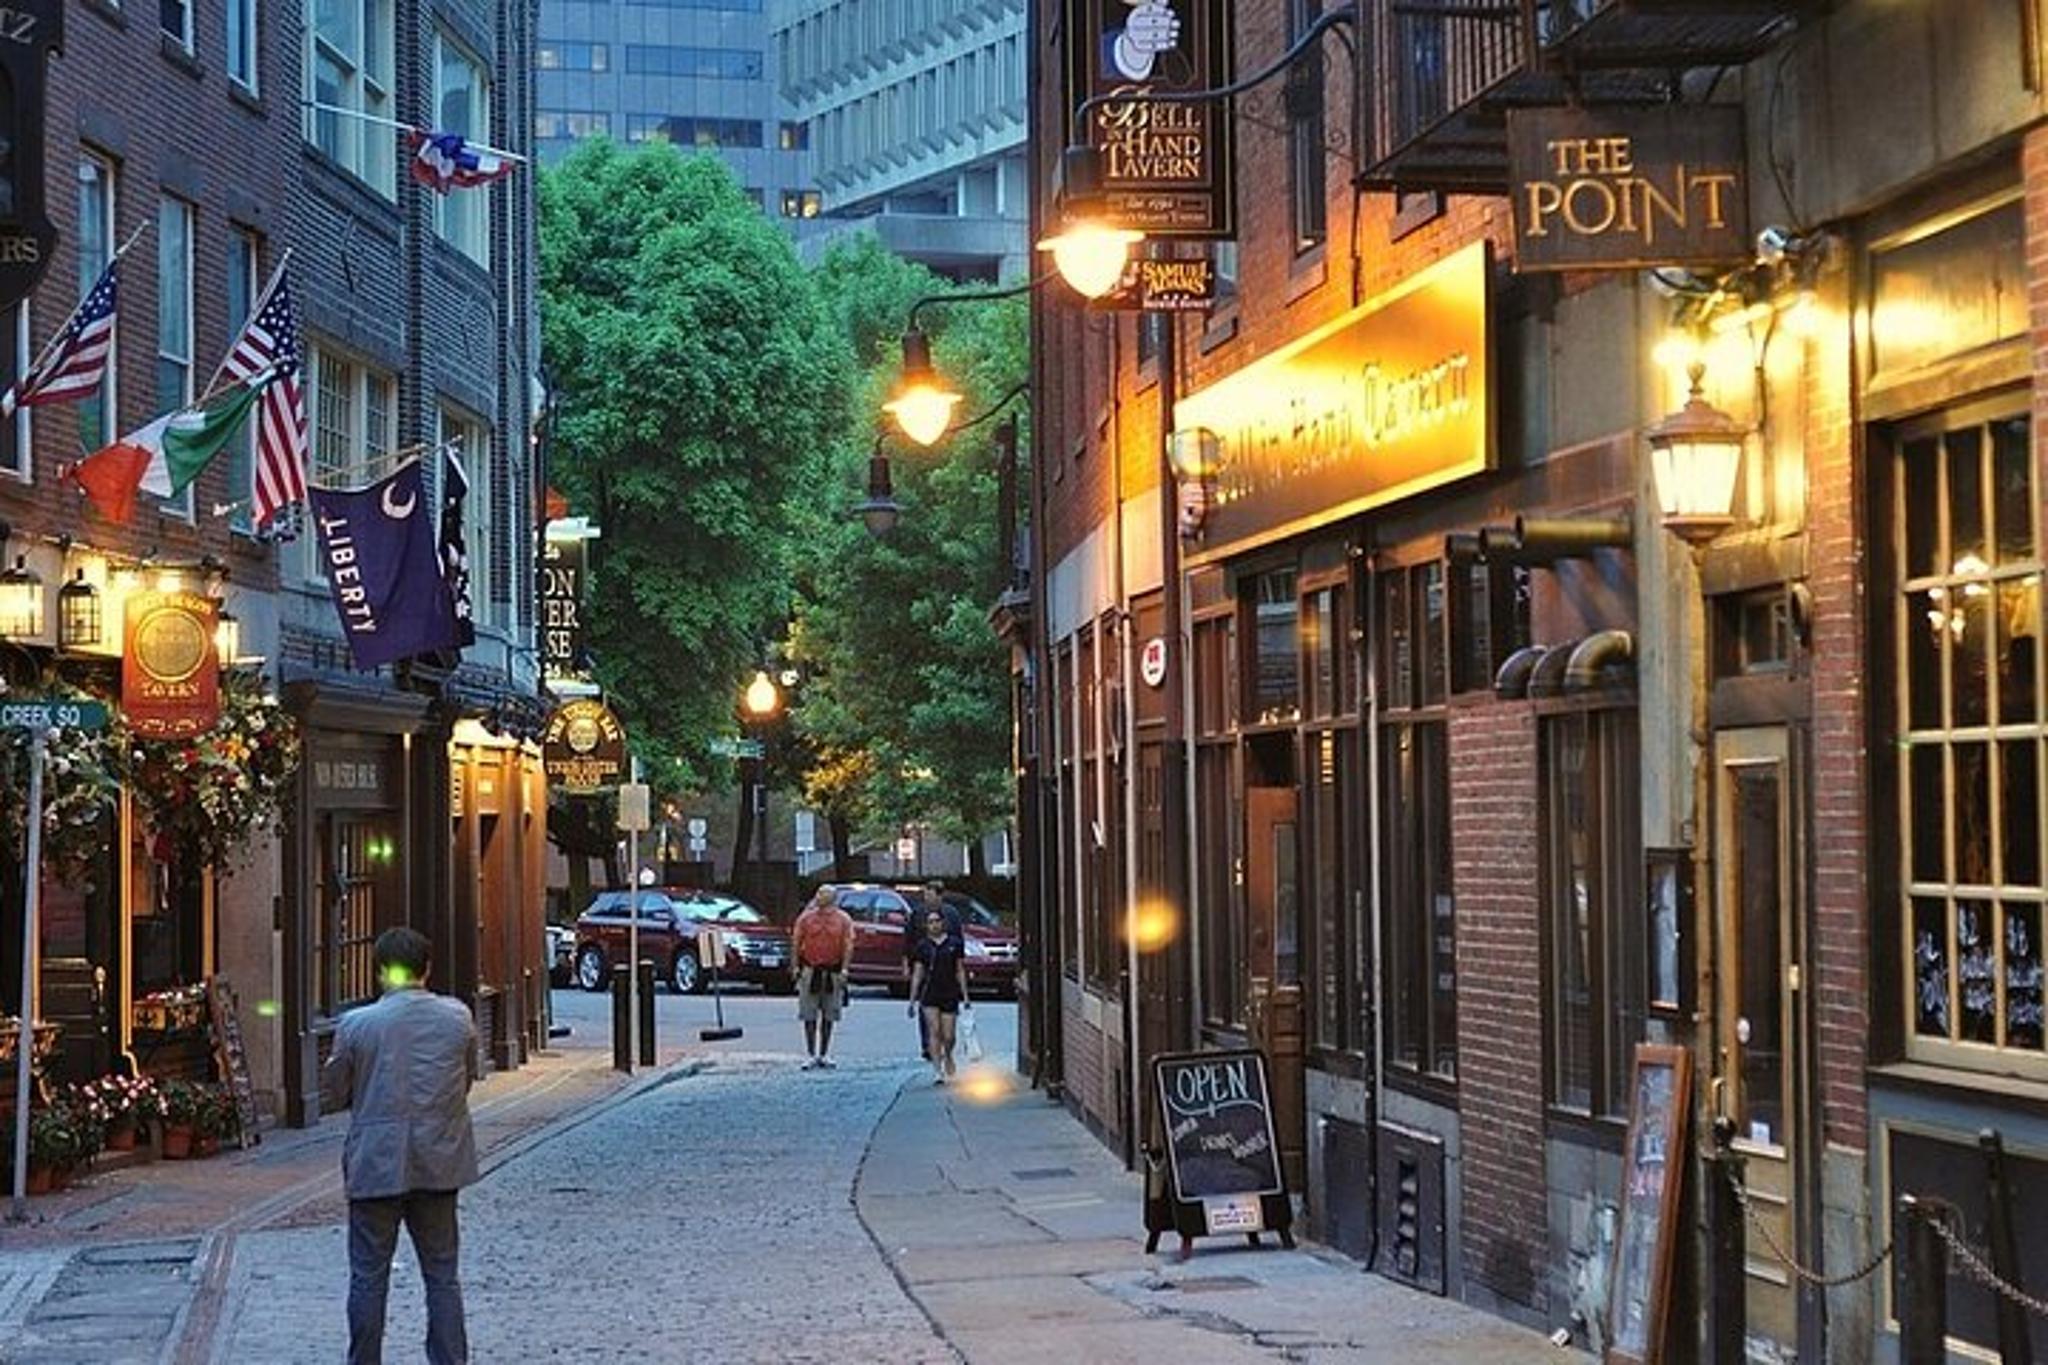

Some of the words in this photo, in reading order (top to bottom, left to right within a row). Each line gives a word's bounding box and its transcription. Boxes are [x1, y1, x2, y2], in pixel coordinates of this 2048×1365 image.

[1098, 84, 1202, 131] BELL
[1100, 142, 1201, 179] TAVERN
[1124, 126, 1202, 157] HAND
[1547, 137, 1634, 176] THE
[1524, 164, 1736, 246] POINT
[1142, 260, 1213, 284] SAMUEL
[1148, 273, 1207, 297] ADAMS
[1360, 350, 1471, 450] Tavern
[326, 518, 377, 632] LIBERTY
[2, 704, 52, 727] CREEK
[1177, 1060, 1250, 1103] OPEN
